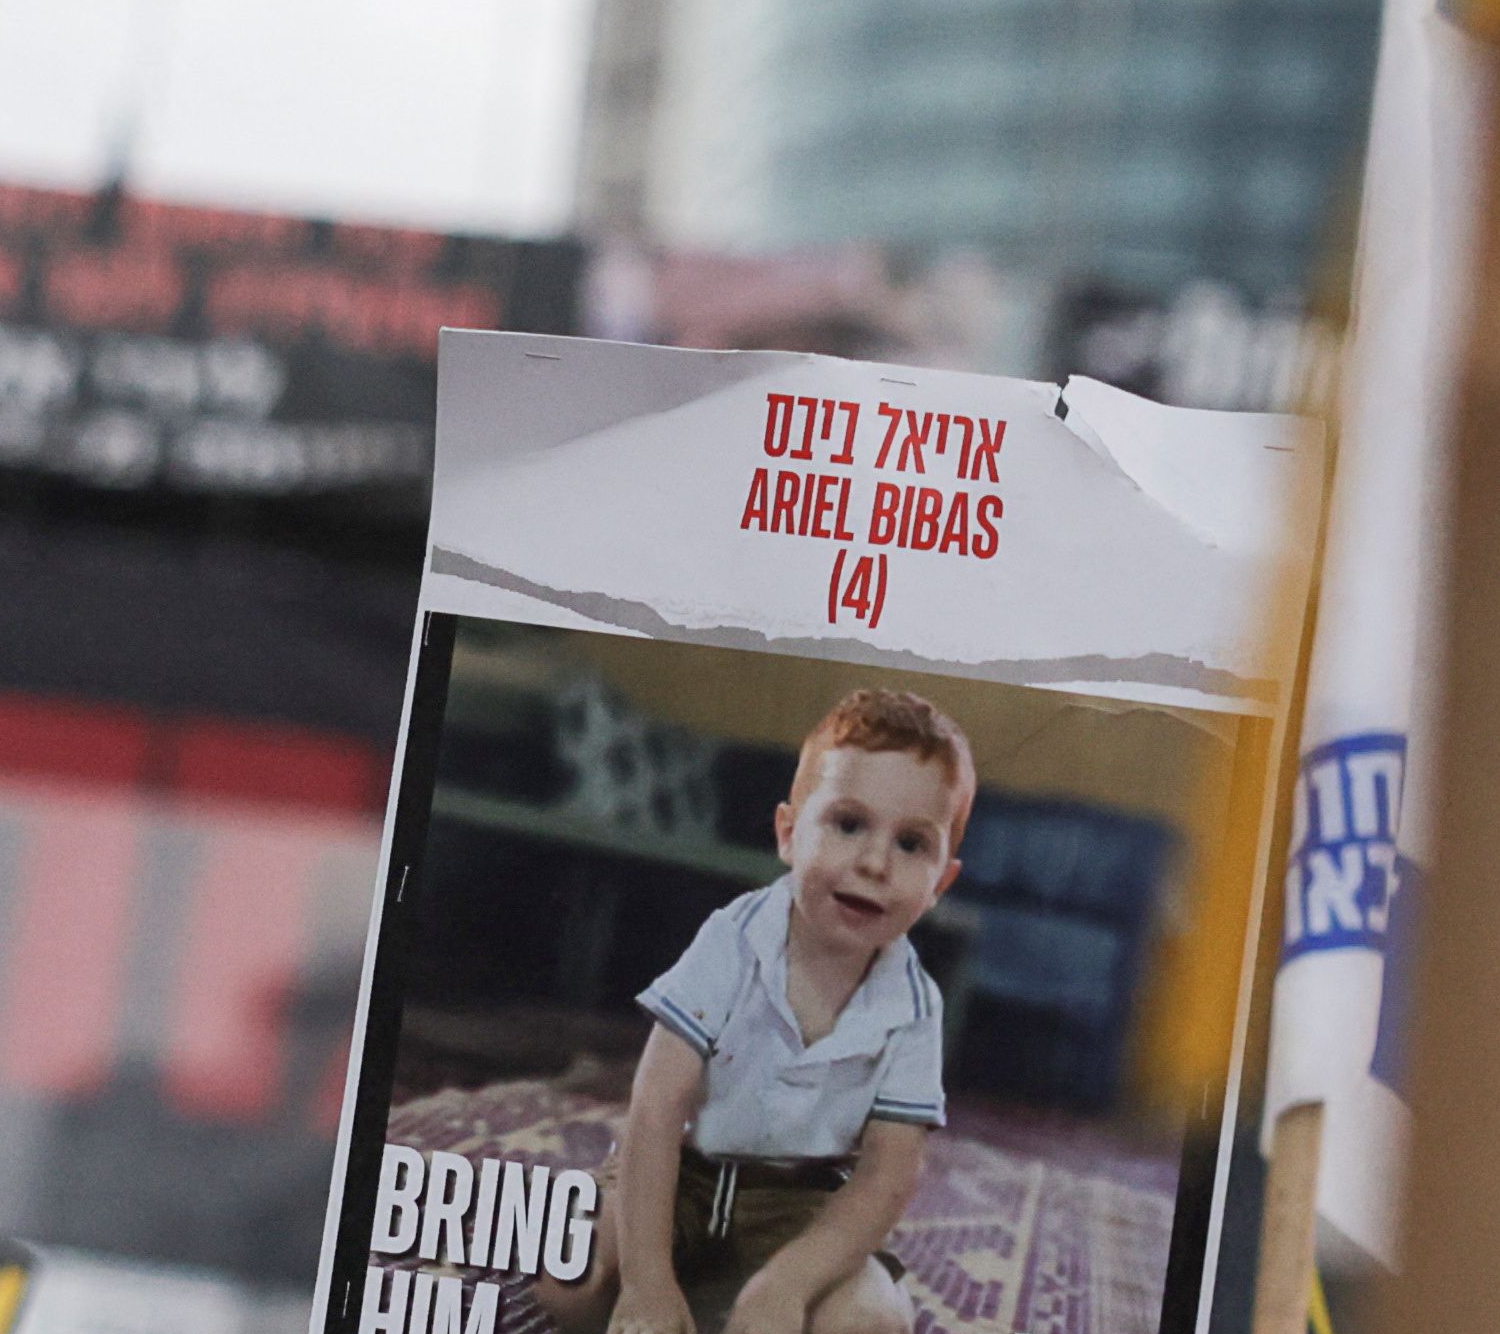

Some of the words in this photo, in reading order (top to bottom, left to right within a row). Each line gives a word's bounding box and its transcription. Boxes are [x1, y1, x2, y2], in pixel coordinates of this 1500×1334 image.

[763, 393, 861, 466] ביבס
[874, 401, 1007, 483] אריאל
[740, 467, 855, 542] ARIEL
[868, 481, 1004, 559] BIBAS
[827, 548, 888, 629] (4)
[370, 1143, 597, 1281] BRING
